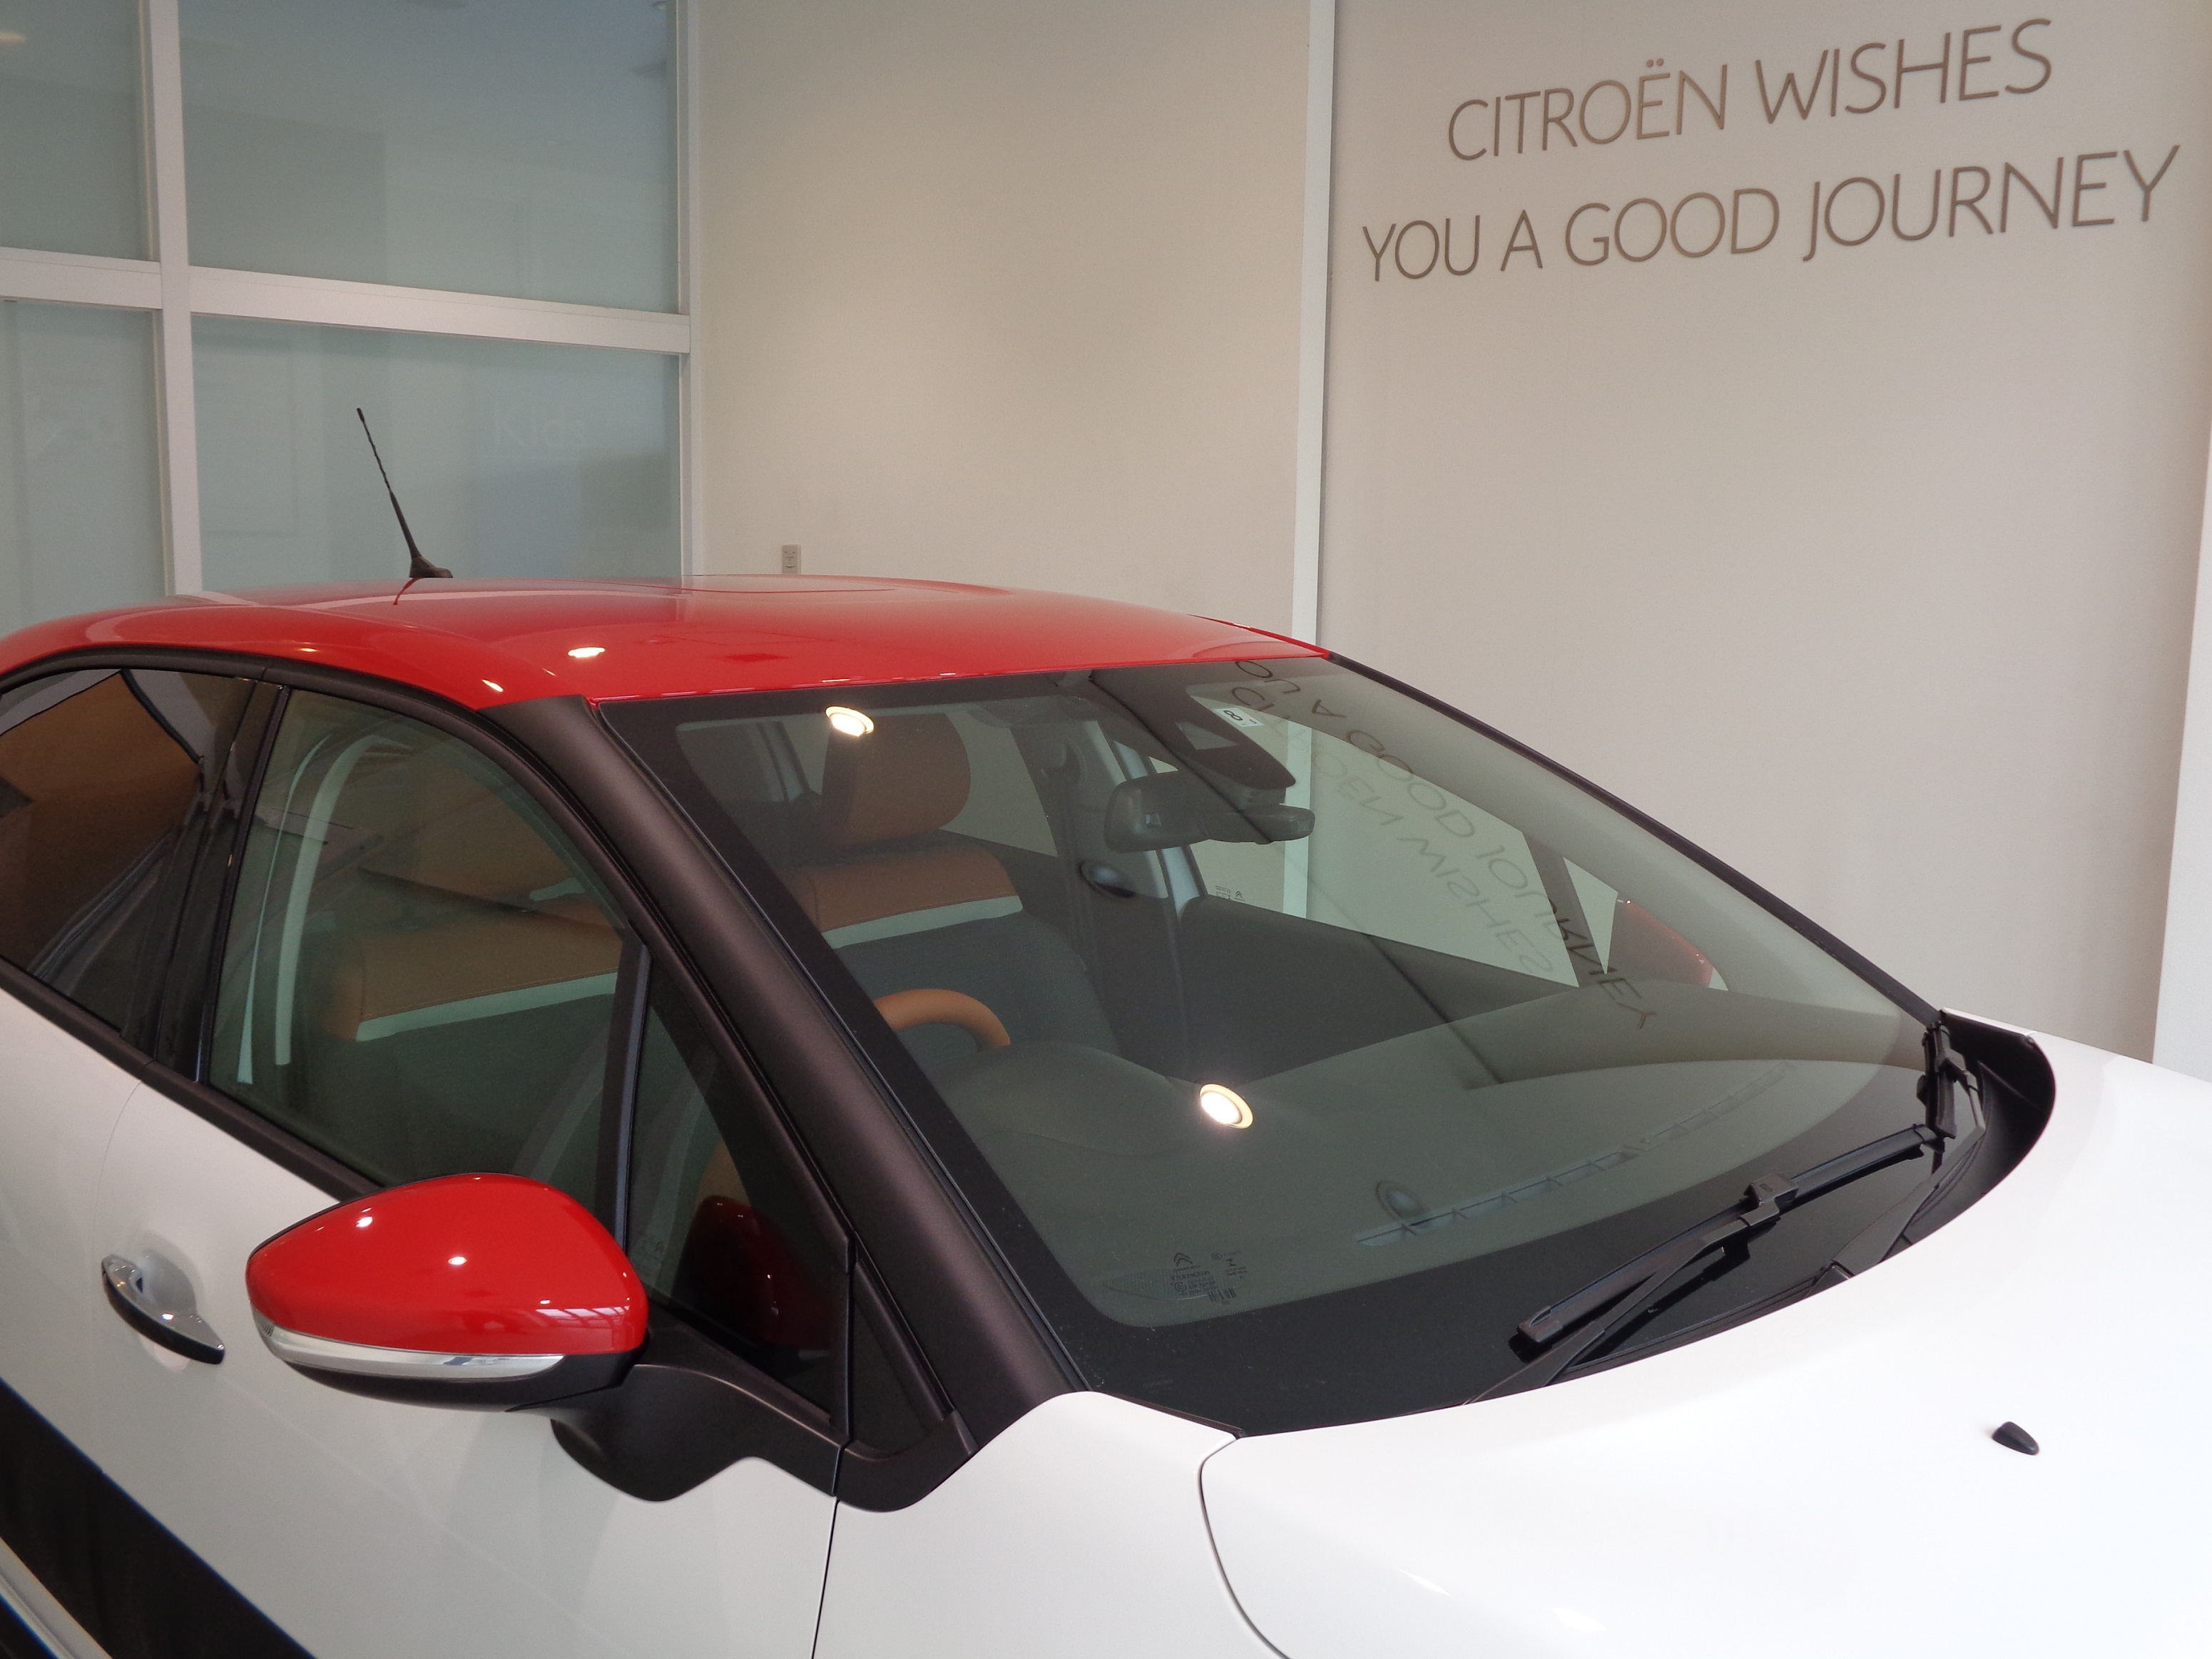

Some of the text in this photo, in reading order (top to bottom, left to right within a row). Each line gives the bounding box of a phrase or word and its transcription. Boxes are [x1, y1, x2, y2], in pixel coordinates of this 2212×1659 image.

[1449, 19, 2052, 161] CITROËN WISHES
[1362, 145, 2181, 282] YOU A GOOD JOURNEY
